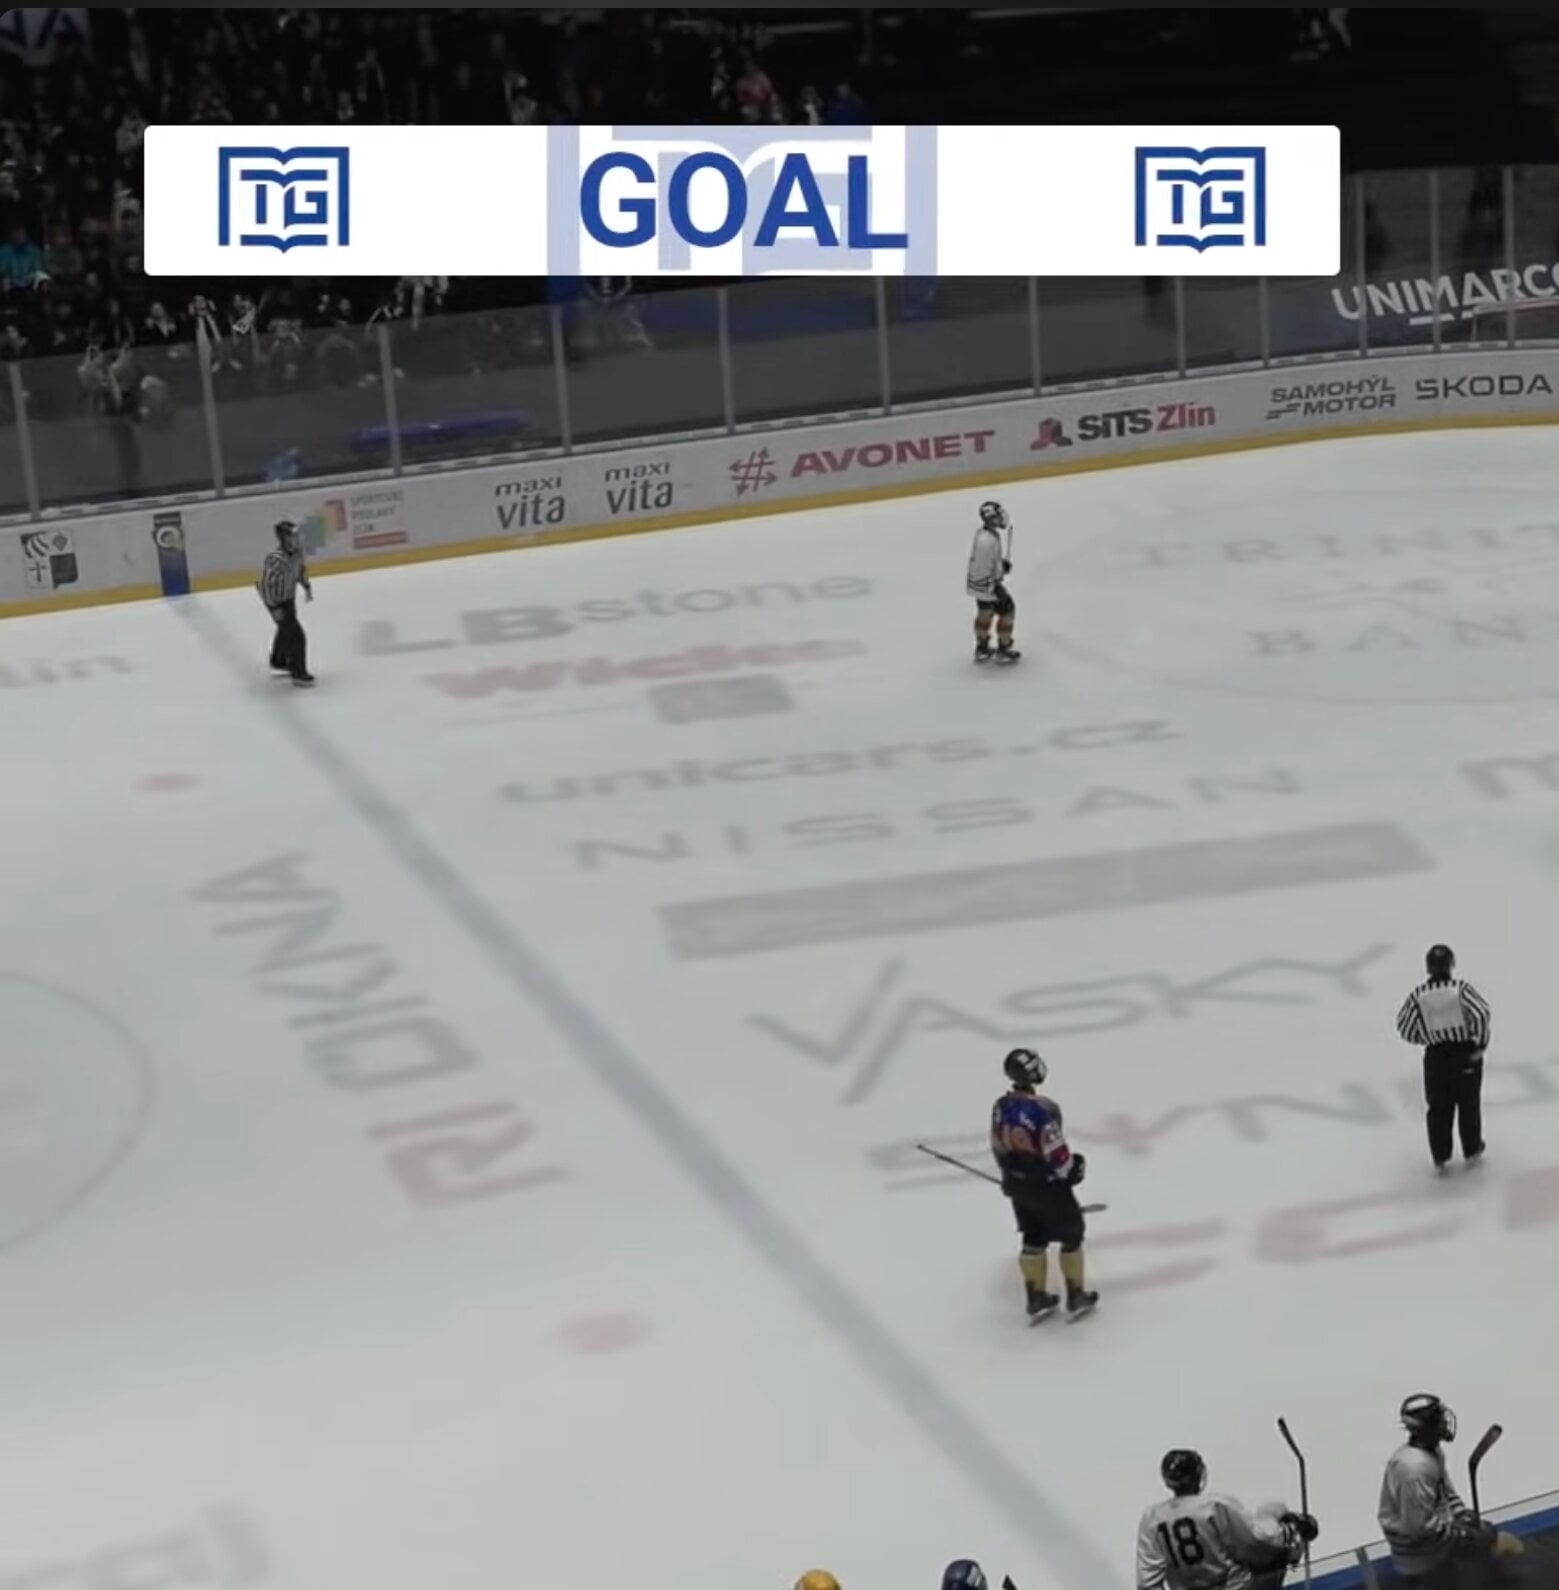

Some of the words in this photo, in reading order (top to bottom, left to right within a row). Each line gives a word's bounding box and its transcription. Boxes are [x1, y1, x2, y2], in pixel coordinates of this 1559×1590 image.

[1271, 375, 1396, 402] SAMOHÝL
[1304, 394, 1396, 416] MOTOR
[1157, 401, 1216, 431] Zlín
[791, 429, 994, 477] AVONET
[495, 477, 561, 496] maxi
[605, 462, 670, 482] maxi
[497, 495, 565, 529] vita
[606, 479, 673, 513] vita
[493, 718, 1184, 804] unicars.cz
[575, 765, 1303, 870] NISSAN
[1158, 1517, 1204, 1568] 18
